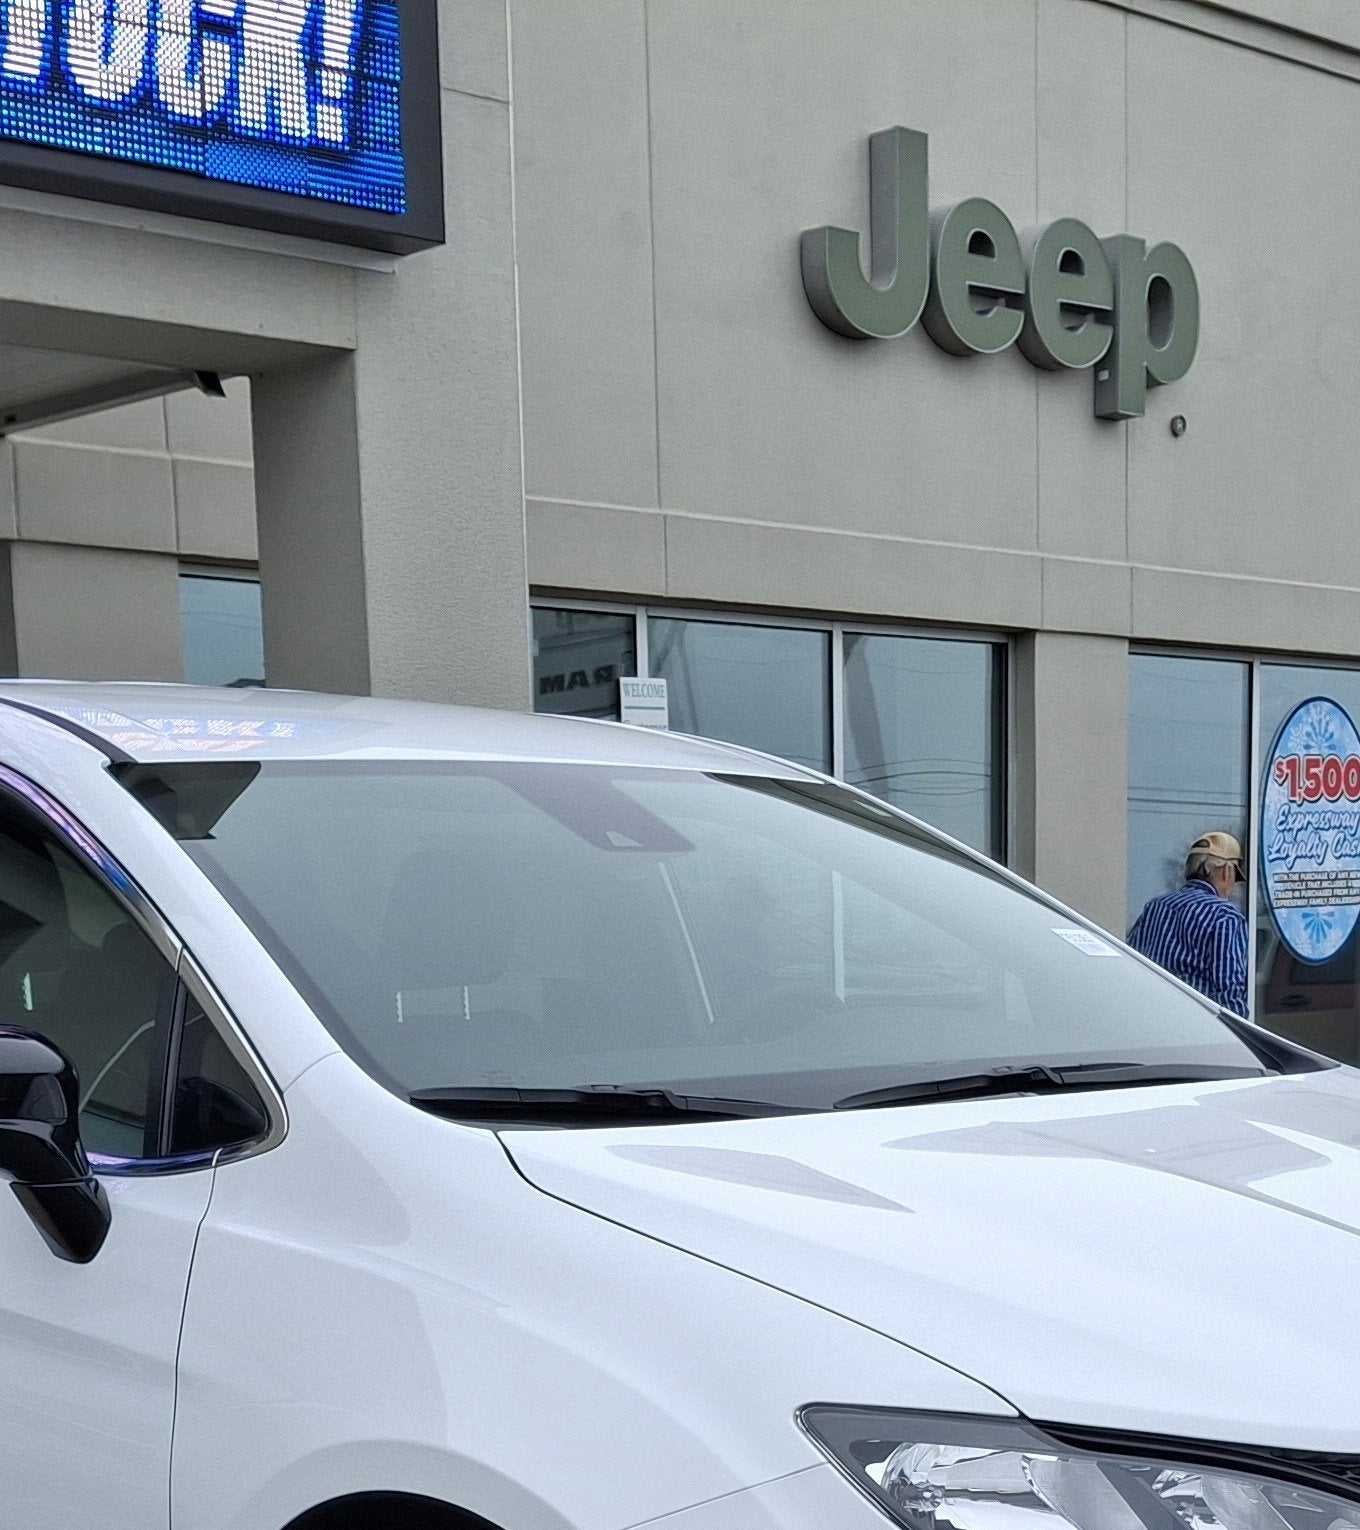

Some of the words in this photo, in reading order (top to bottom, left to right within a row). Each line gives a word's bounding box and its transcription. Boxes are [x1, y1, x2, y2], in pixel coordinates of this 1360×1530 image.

[800, 125, 1200, 421] Jeep
[622, 683, 666, 699] WELCOME
[1276, 803, 1360, 841] Expressway
[1267, 830, 1329, 870] Loyalty
